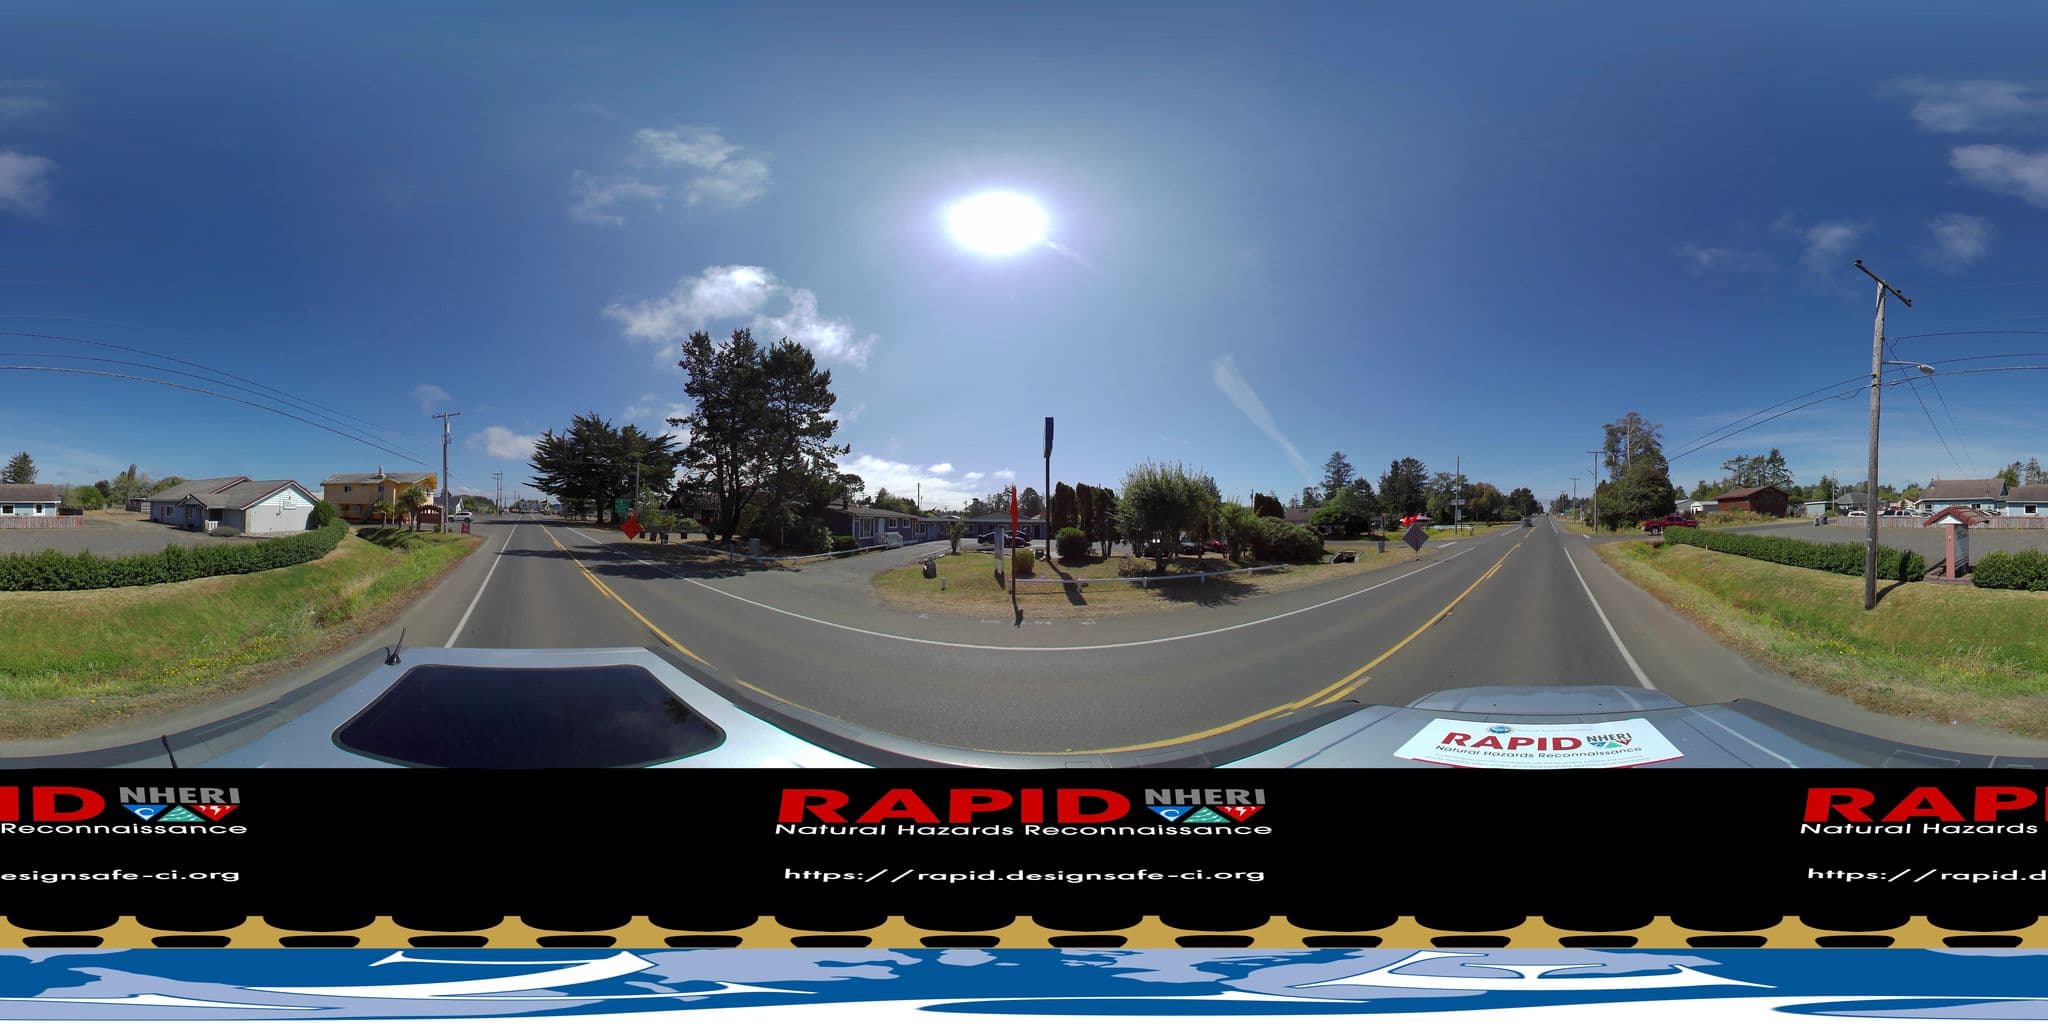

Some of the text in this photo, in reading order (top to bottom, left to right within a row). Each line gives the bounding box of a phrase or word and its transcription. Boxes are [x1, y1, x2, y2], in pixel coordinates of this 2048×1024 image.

[1440, 732, 1582, 751] RAPID
[1585, 732, 1632, 743] NHERI
[1435, 745, 1480, 755] Natural
[1538, 747, 1642, 758] Reconnaissance
